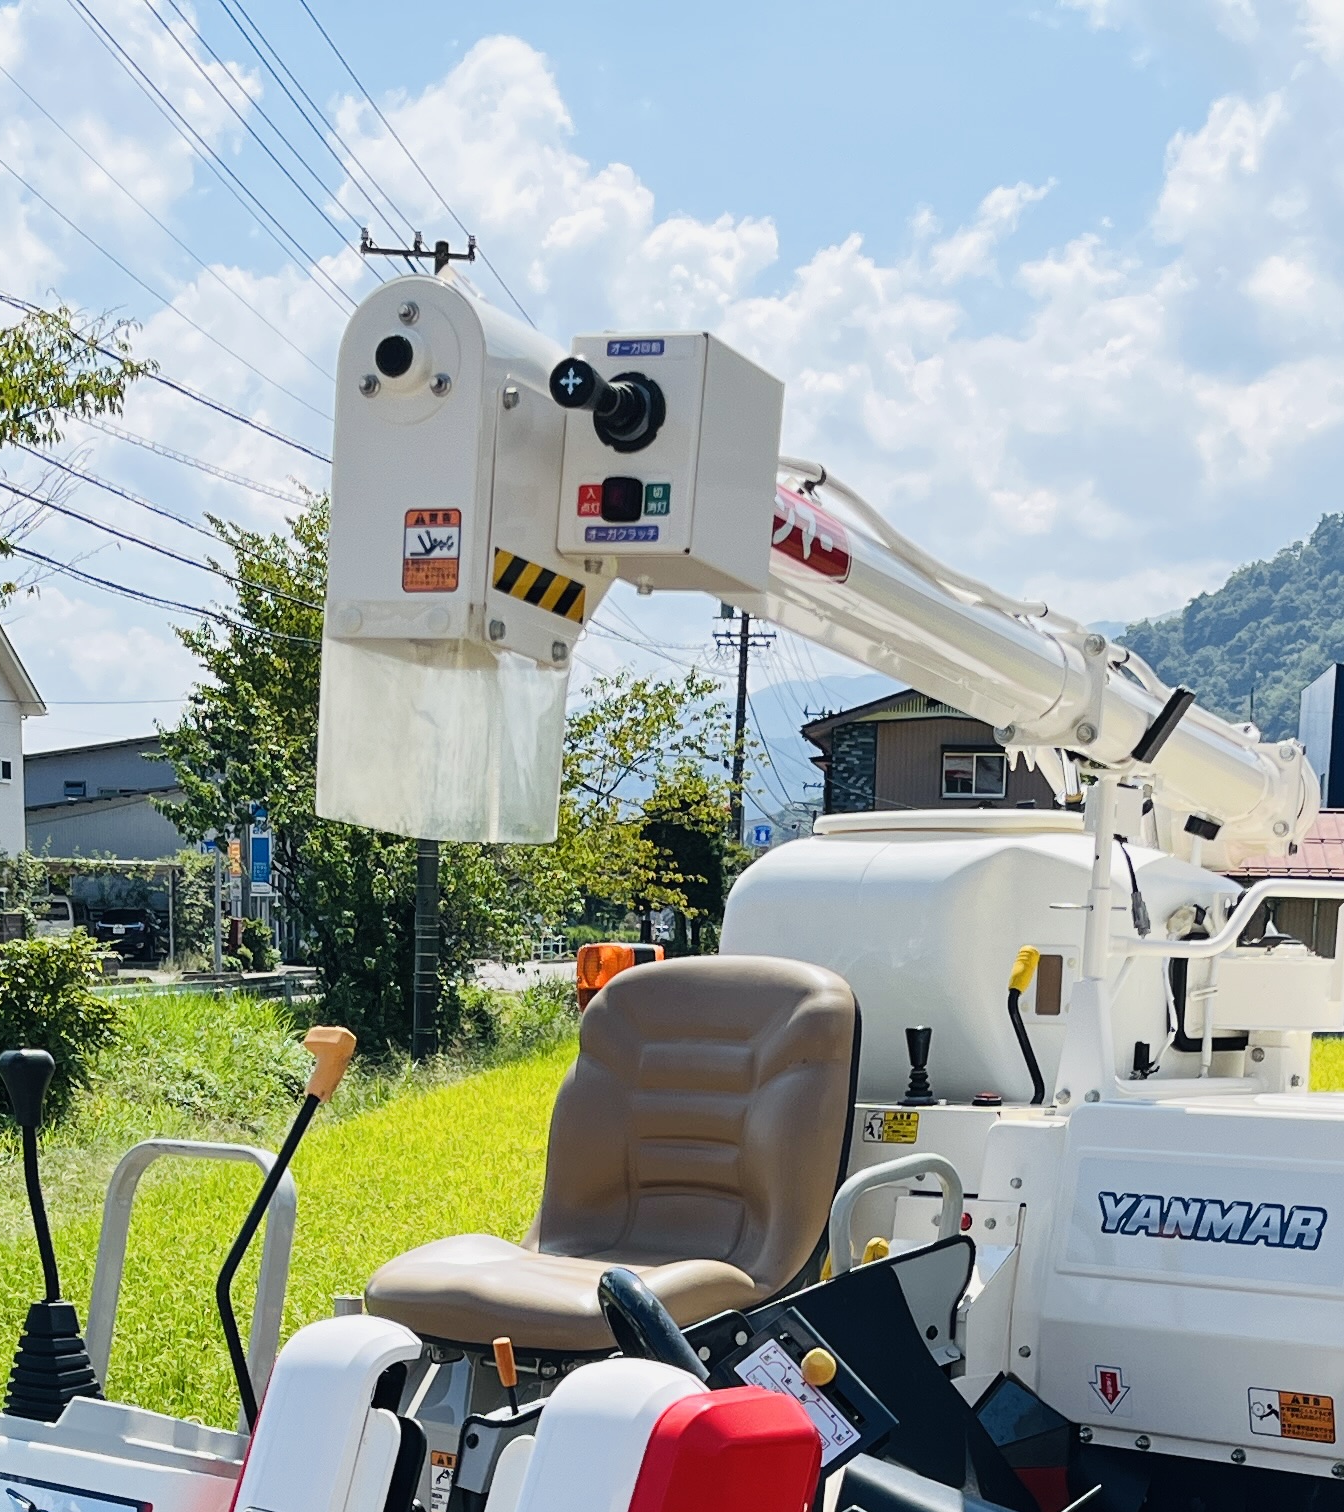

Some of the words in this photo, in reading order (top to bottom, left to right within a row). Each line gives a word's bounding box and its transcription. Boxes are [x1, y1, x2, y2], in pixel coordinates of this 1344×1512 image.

[586, 487, 596, 500] 入
[587, 528, 656, 541] オーガクラッチ
[1098, 1191, 1327, 1250] YANMAR
